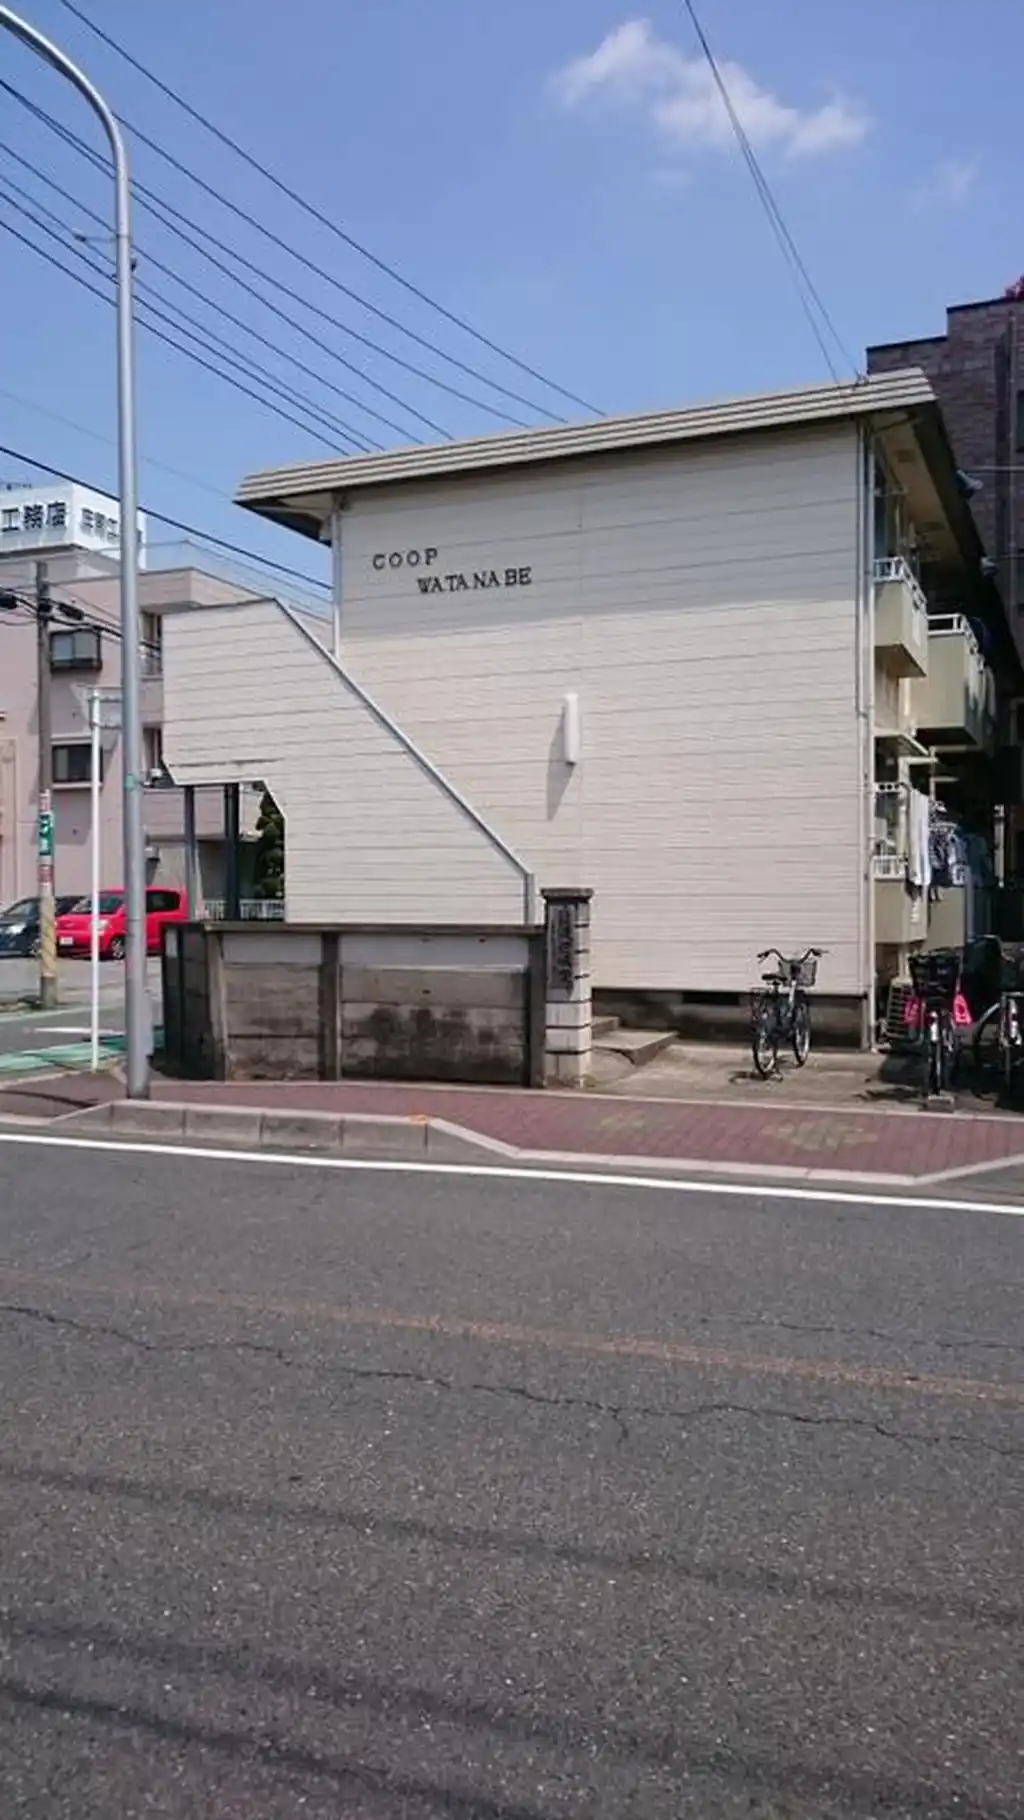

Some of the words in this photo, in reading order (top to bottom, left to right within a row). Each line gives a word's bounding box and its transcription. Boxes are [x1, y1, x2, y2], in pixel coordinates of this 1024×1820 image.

[1, 501, 66, 532] 工務店
[372, 547, 438, 570] COOP
[417, 566, 533, 594] WATANABE
